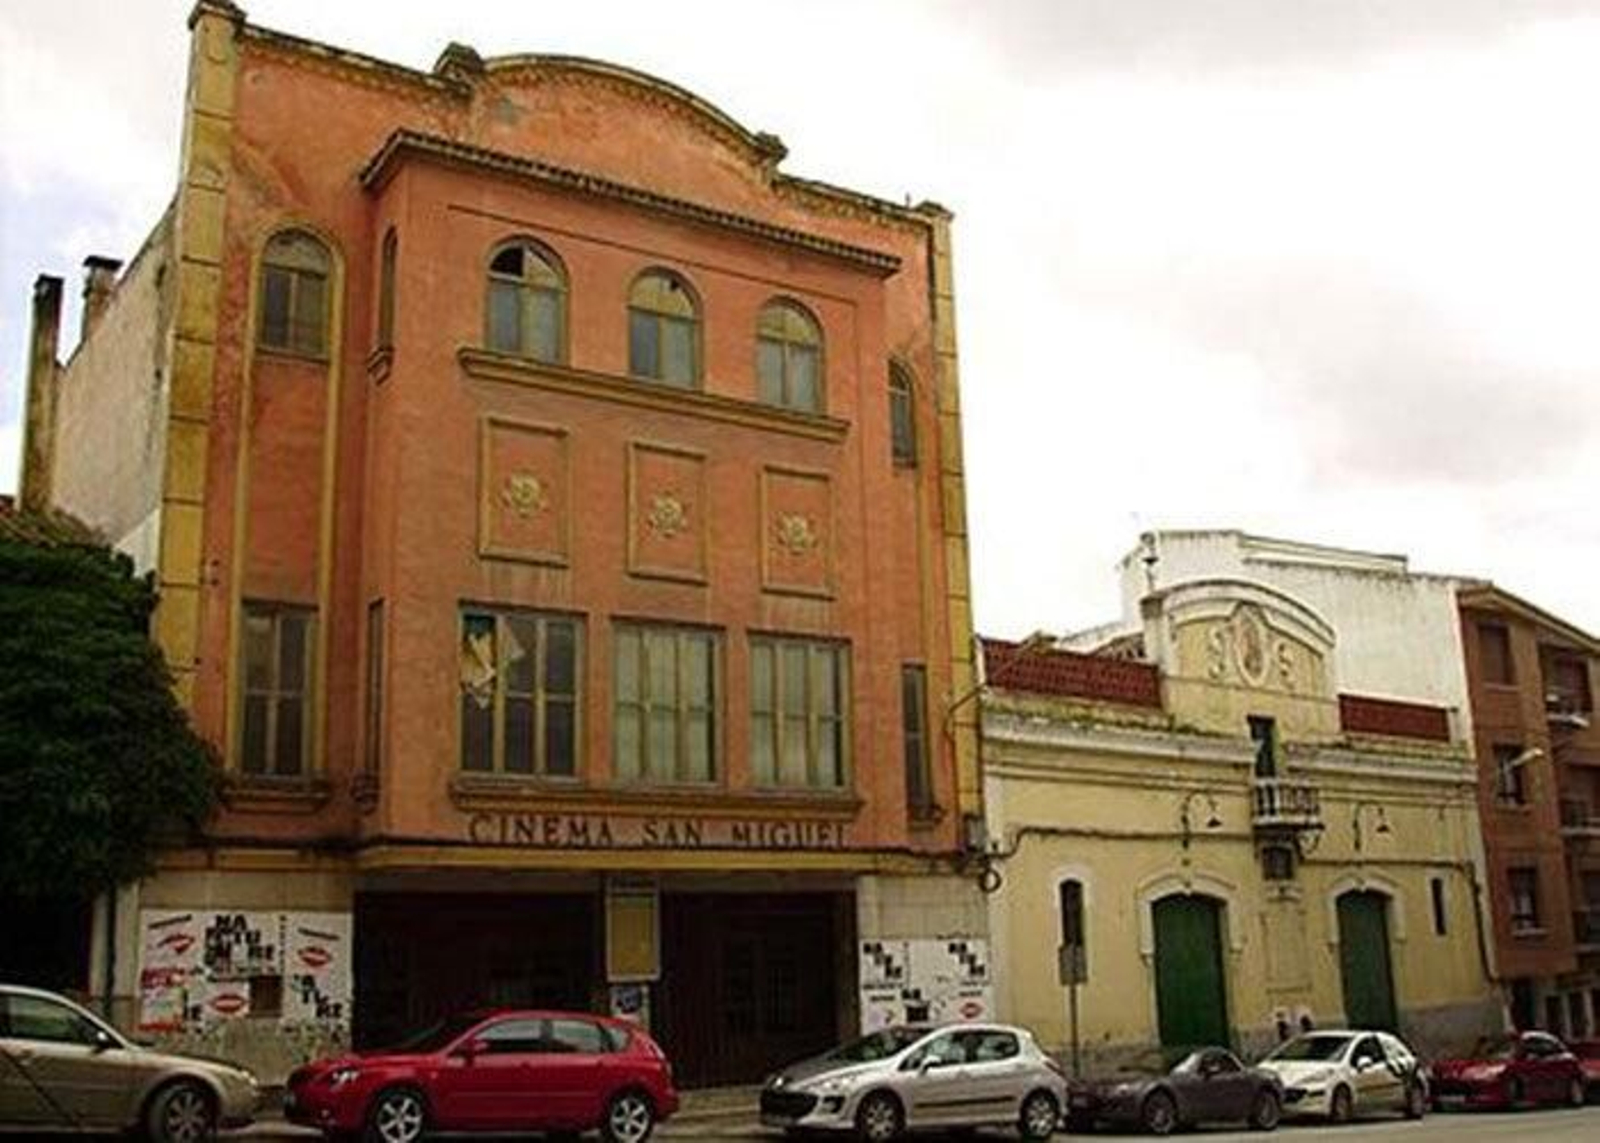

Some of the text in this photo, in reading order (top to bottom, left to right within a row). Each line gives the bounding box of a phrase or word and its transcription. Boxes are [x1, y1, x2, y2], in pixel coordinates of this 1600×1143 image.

[468, 812, 848, 849] CINEMA SAN MIGUEL
